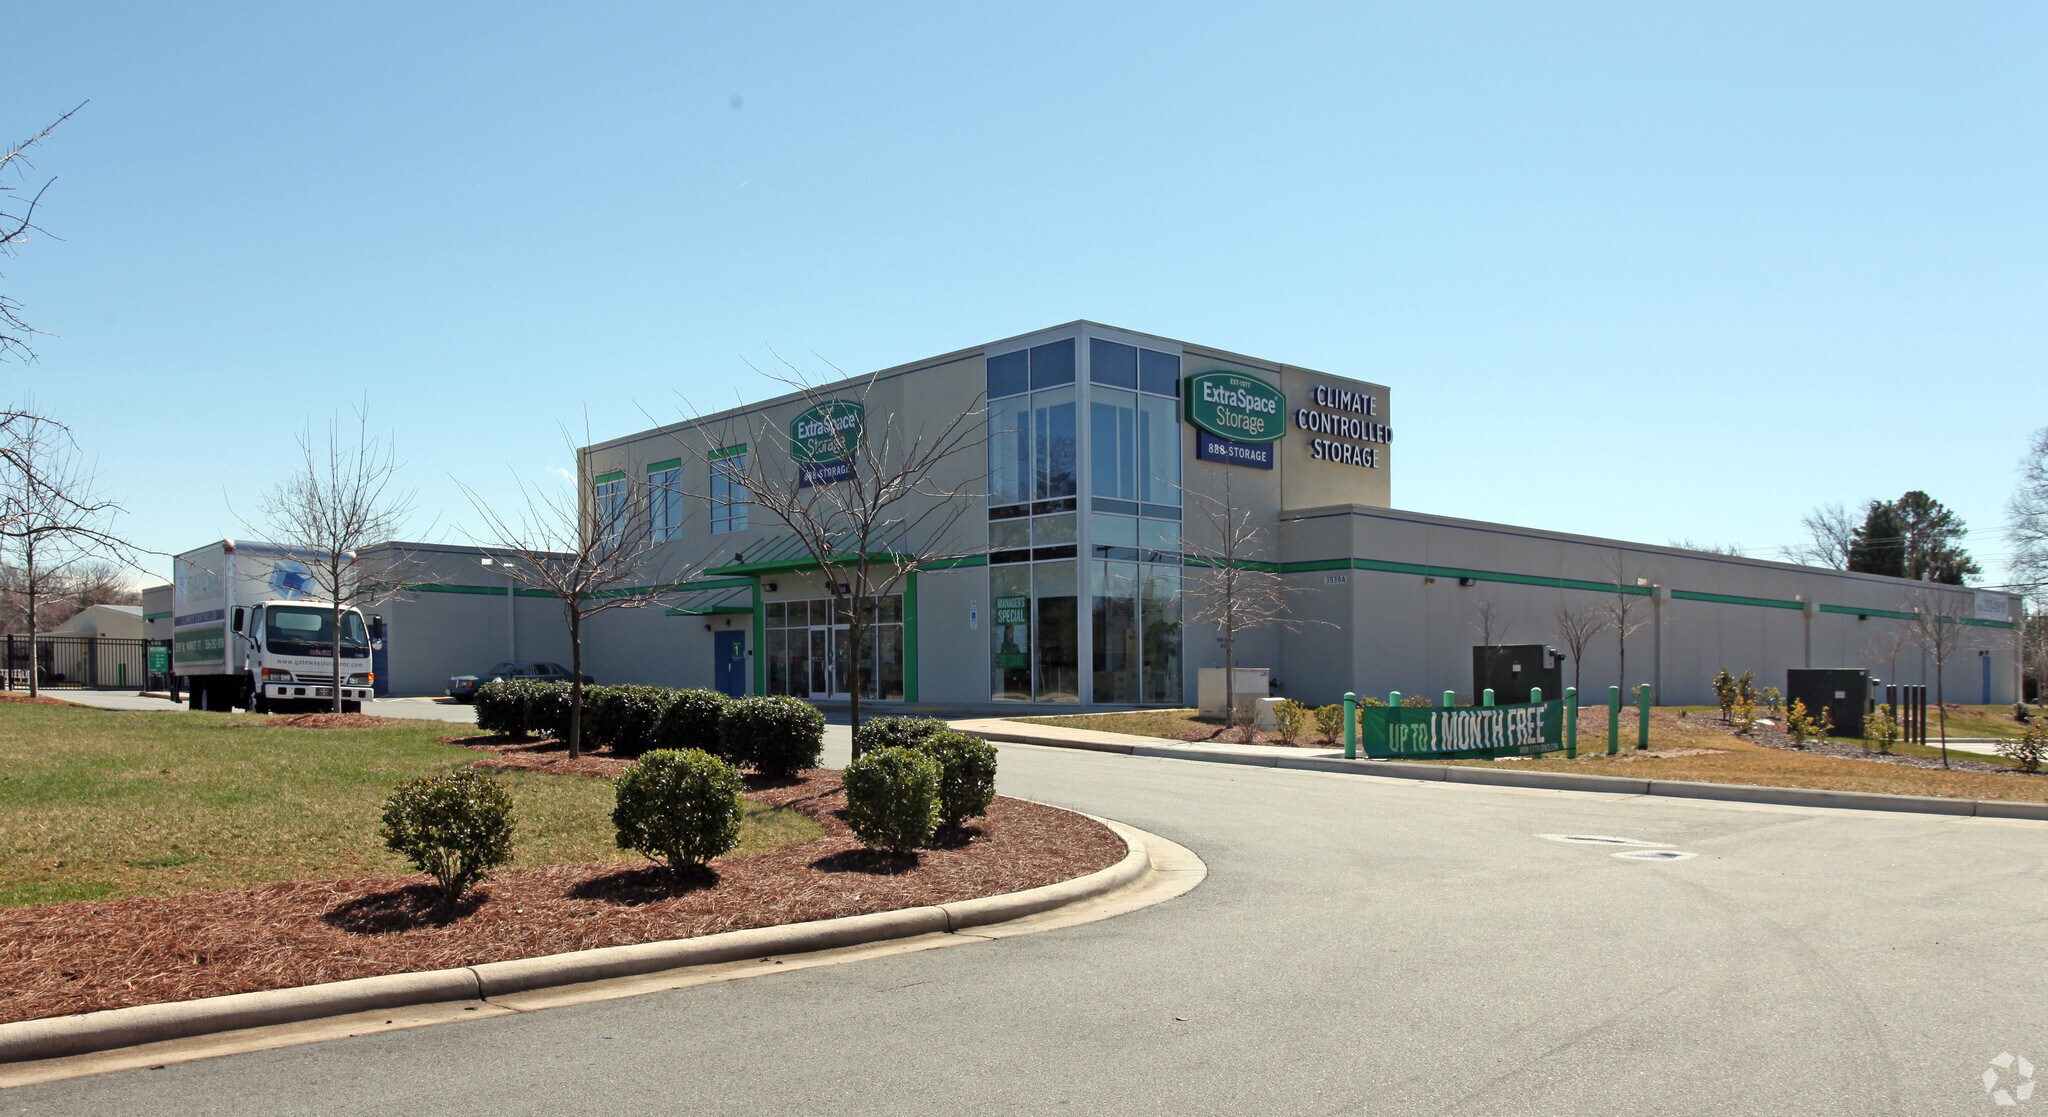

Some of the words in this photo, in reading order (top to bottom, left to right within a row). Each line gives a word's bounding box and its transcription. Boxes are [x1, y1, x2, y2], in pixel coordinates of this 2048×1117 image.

[1316, 385, 1377, 416] CLIMATE
[1216, 406, 1265, 435] Storage
[1297, 408, 1394, 445] CONTROLLED
[1208, 443, 1267, 462] 888-STORAGE
[1313, 438, 1380, 469] STORAGE
[1326, 576, 1346, 584] 3939A
[997, 597, 1025, 608] MANAGER'S
[998, 609, 1025, 622] SPECIAL
[734, 645, 739, 656] 1
[1388, 723, 1408, 753] UP
[1412, 722, 1428, 752] TO
[1442, 709, 1505, 750] MONTH
